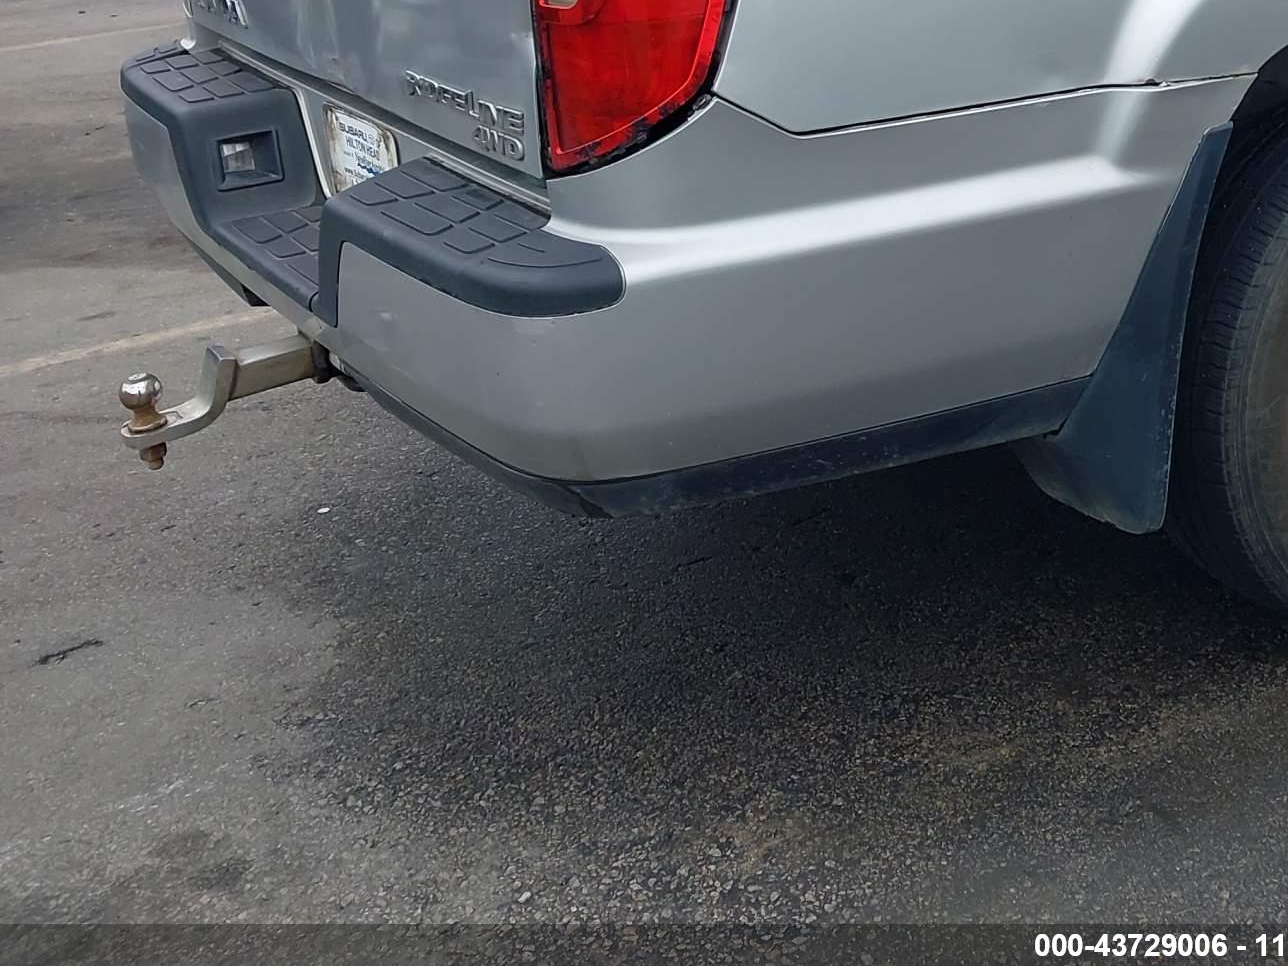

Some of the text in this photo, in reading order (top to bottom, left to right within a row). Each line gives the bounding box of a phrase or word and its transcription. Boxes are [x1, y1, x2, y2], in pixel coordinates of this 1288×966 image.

[338, 121, 369, 143] SUBARU
[472, 125, 525, 161] 4WD
[345, 135, 368, 155] HILTON
